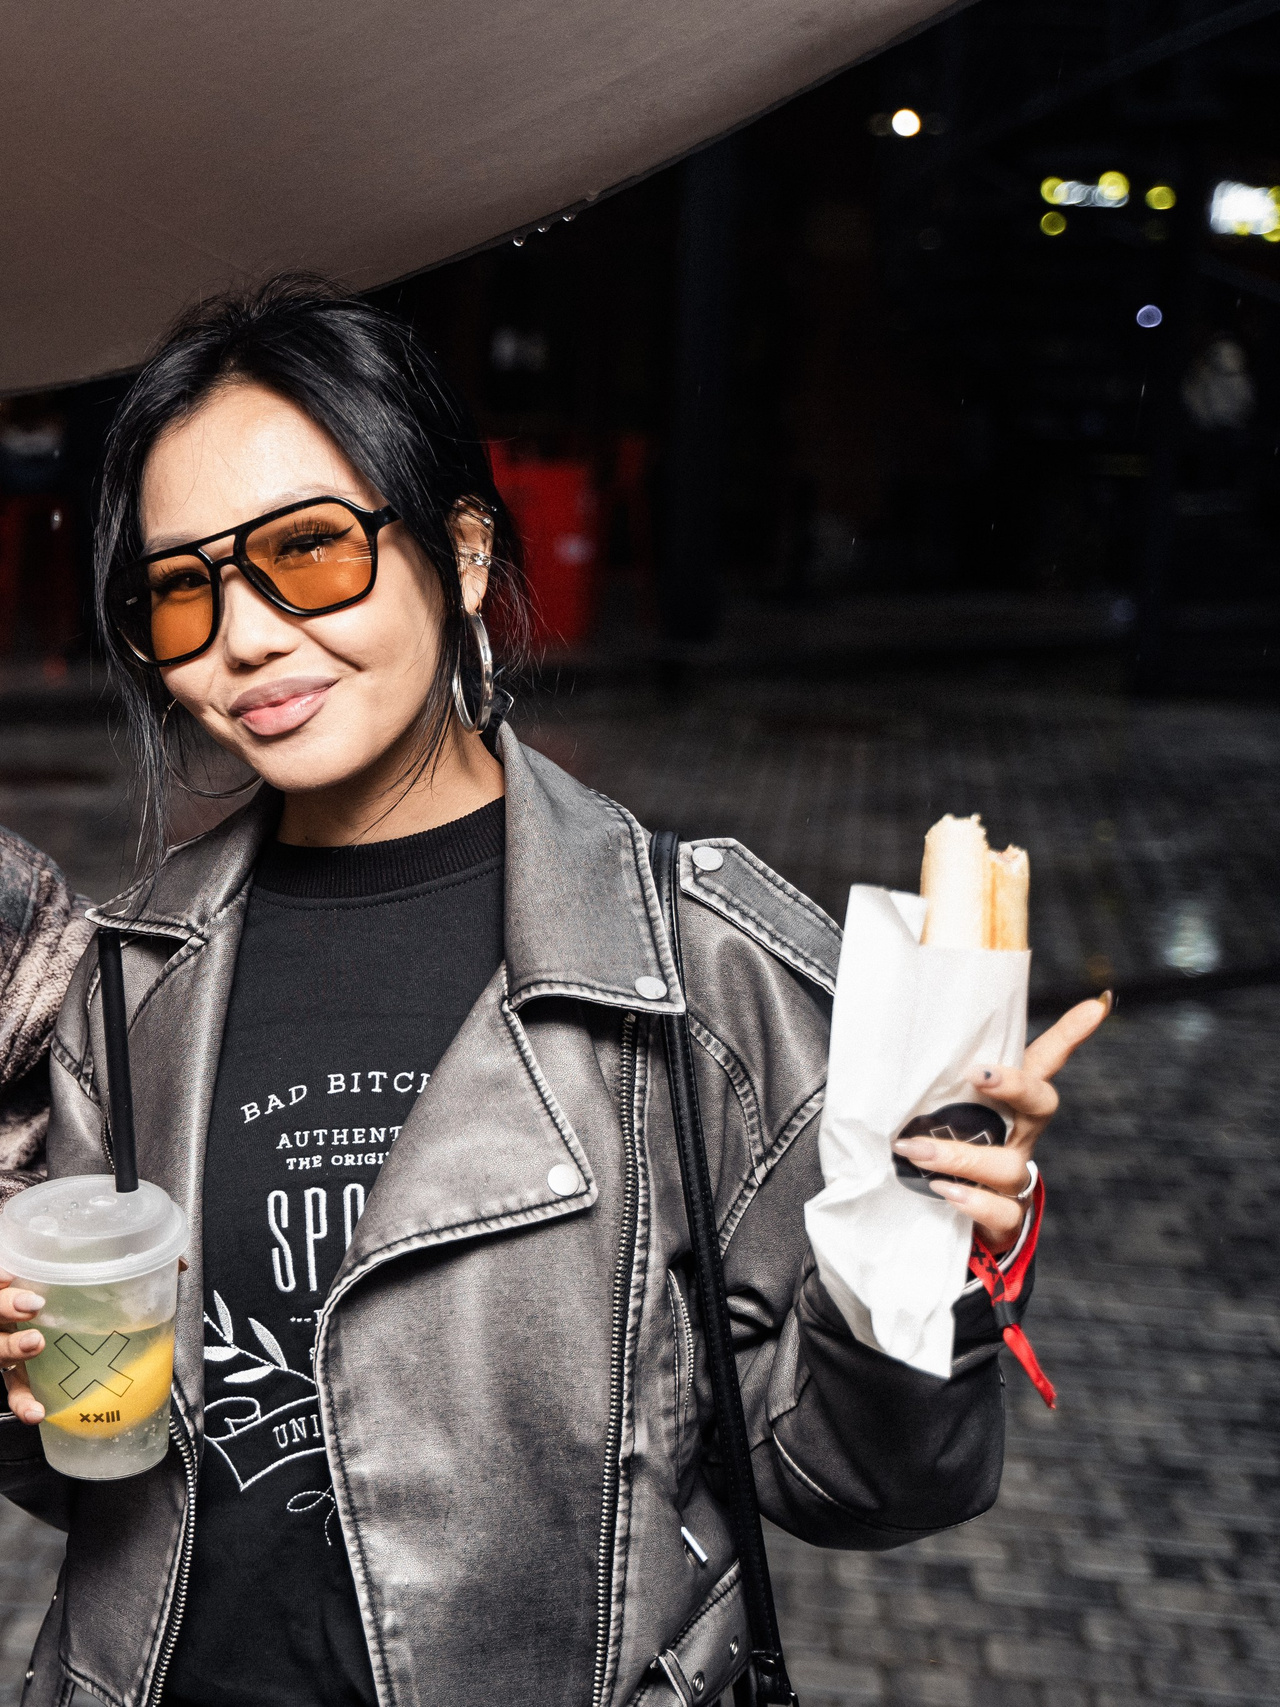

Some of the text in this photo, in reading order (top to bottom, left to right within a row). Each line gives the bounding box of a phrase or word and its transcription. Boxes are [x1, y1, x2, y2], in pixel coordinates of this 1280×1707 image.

[240, 1084, 308, 1124] BAD
[275, 1125, 402, 1150] AUTHENT
[286, 1151, 389, 1170] THE ORIGI
[271, 1414, 321, 1449] UNI
